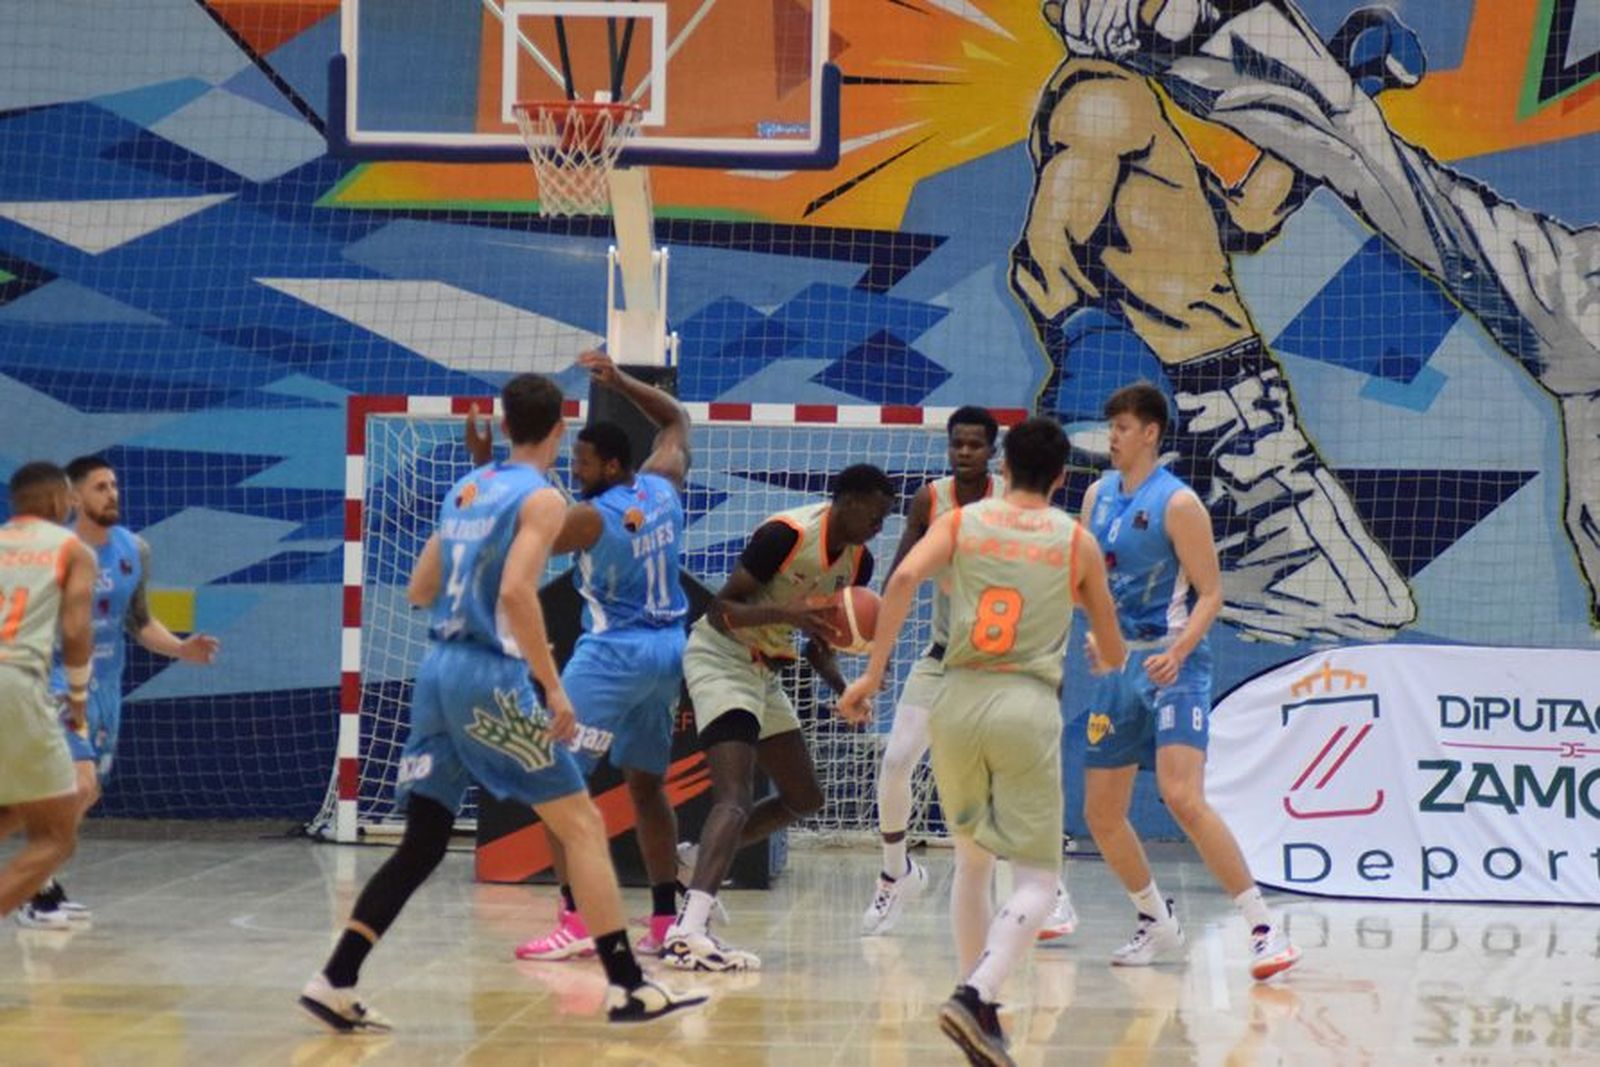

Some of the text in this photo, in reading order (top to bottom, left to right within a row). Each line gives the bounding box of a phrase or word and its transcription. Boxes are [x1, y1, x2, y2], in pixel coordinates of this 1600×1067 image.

[643, 554, 671, 610] 11
[971, 585, 1025, 656] 8
[1192, 706, 1203, 732] 8
[1437, 694, 1600, 734] DIPUTA
